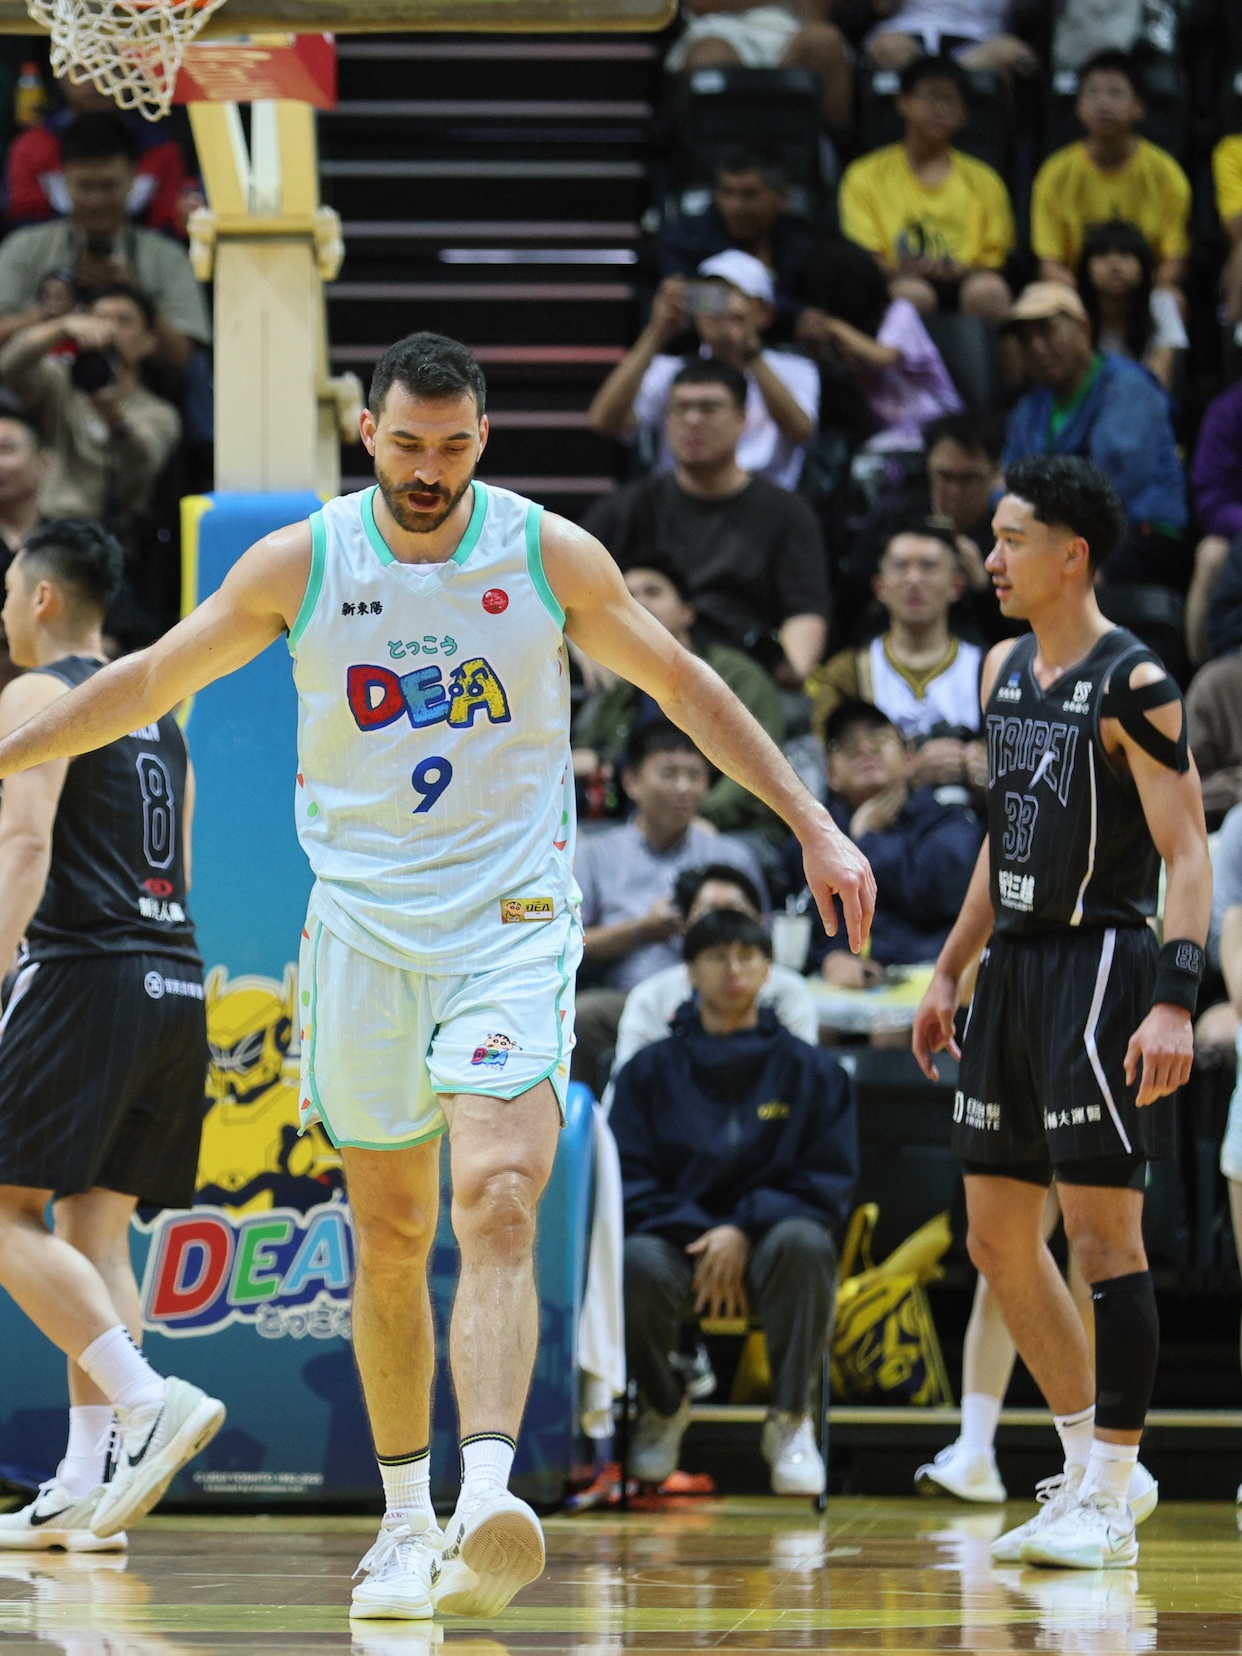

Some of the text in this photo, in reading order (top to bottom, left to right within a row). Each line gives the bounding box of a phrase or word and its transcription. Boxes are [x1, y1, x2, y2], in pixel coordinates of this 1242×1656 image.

[342, 601, 383, 616] 新東陽
[388, 635, 458, 659] とっこう
[346, 656, 512, 732] DEA
[412, 756, 453, 814] 9
[986, 714, 1079, 808] TAIPEI
[136, 752, 175, 870] 8
[1002, 791, 1039, 863] 33
[470, 1047, 509, 1066] DEA
[146, 1210, 352, 1322] DEA
